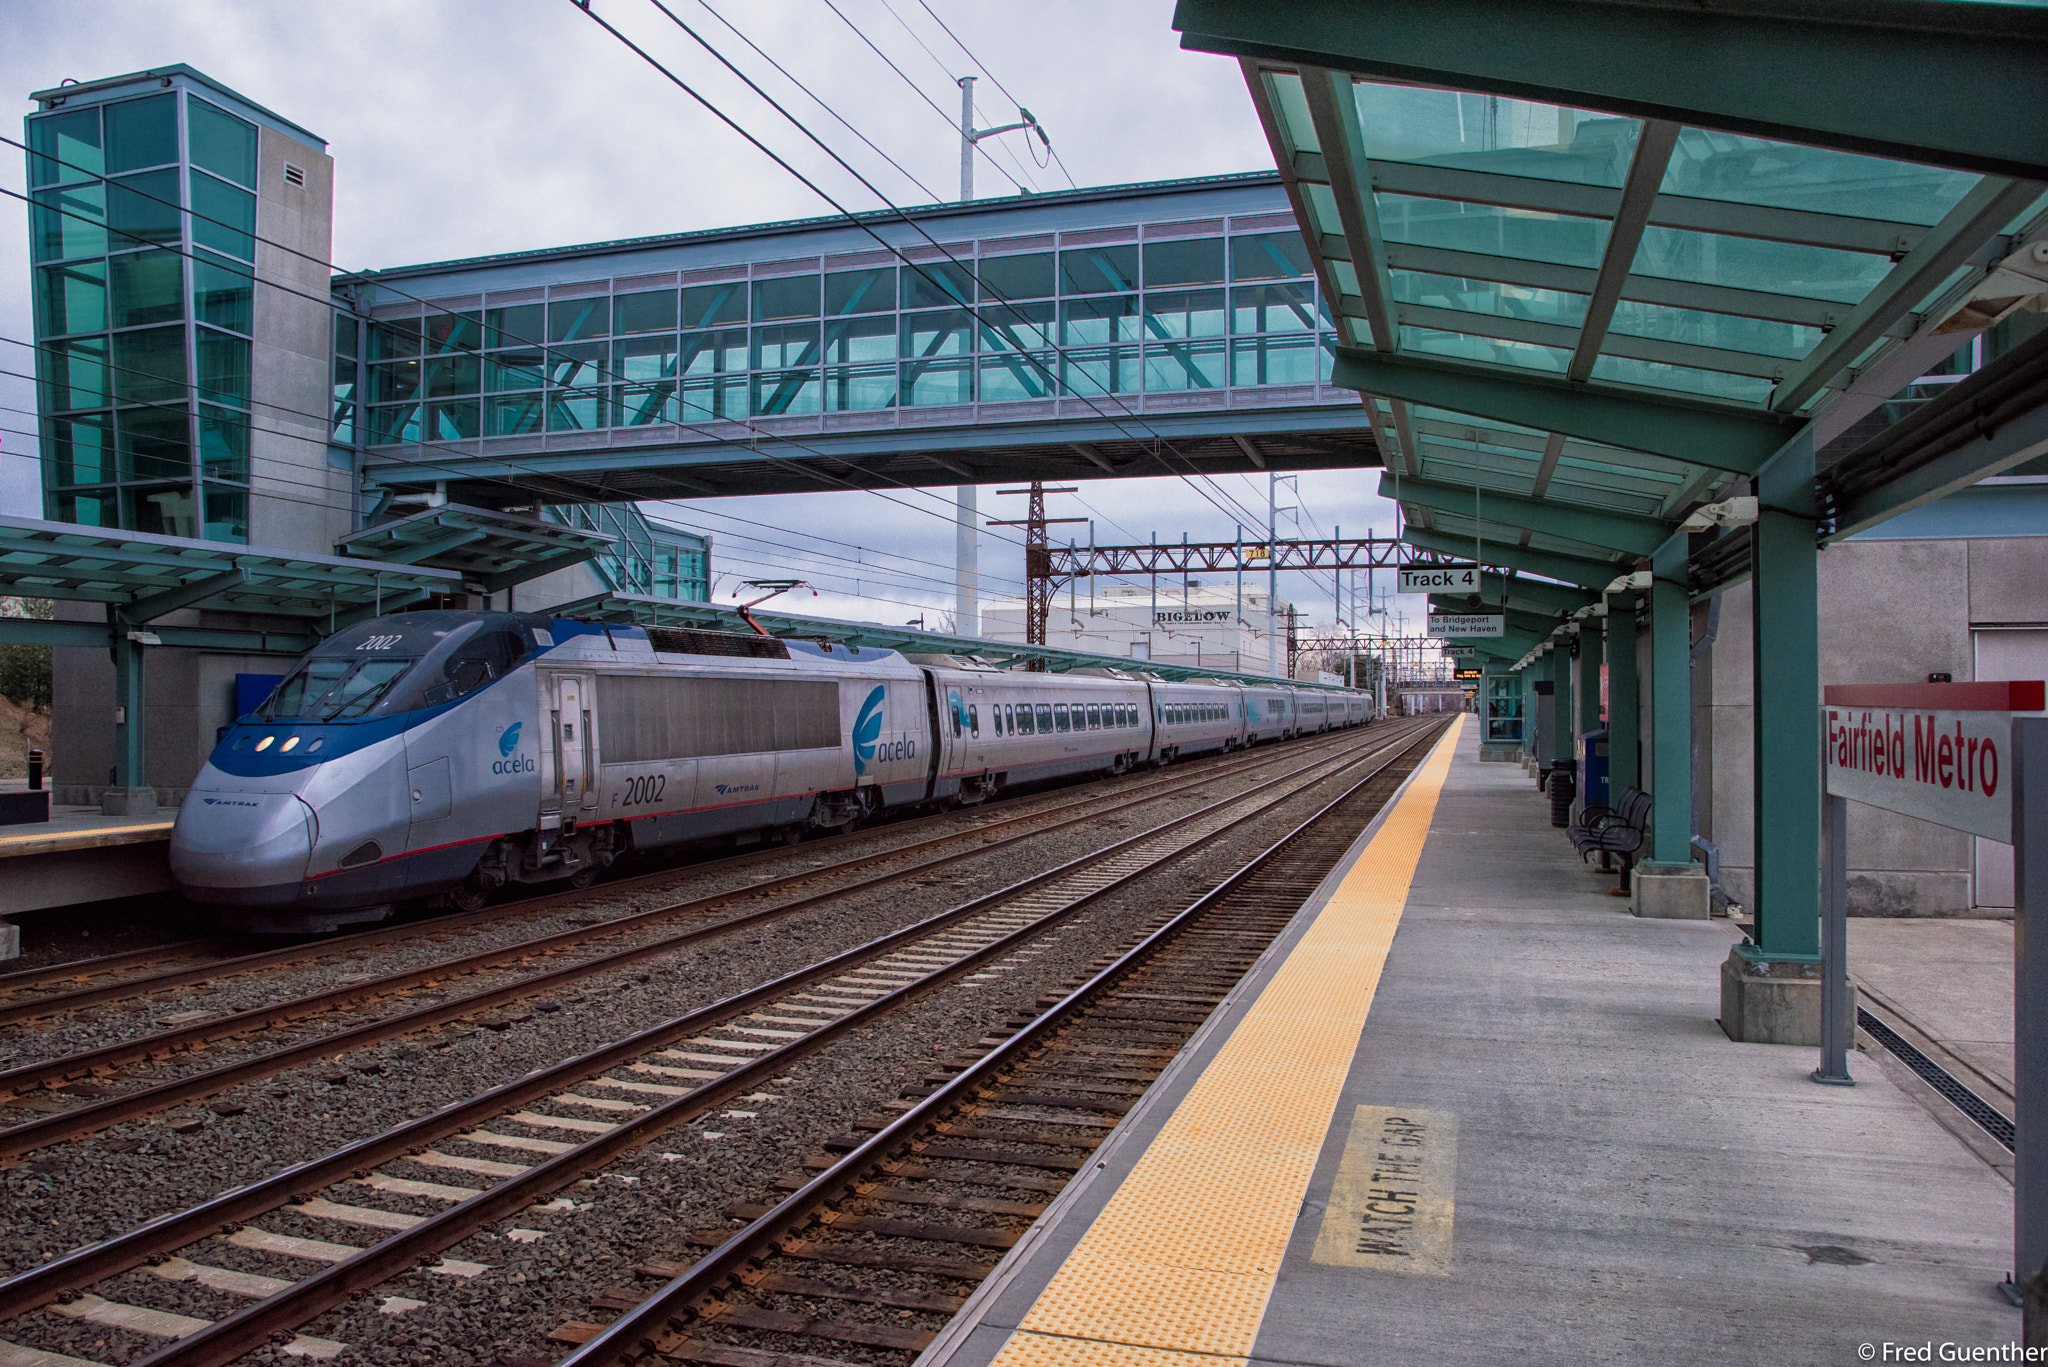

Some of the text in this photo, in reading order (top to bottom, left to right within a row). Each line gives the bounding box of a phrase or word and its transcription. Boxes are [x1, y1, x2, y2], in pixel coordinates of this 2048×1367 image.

[1249, 549, 1266, 558] 718
[1401, 570, 1474, 586] Track 4
[1156, 611, 1231, 622] BIGELOW
[1429, 616, 1489, 625] To Bridgeport
[1429, 625, 1497, 633] and New Haven
[355, 634, 403, 650] 2002
[1443, 648, 1465, 656] Track
[878, 731, 915, 763] acela
[1828, 710, 1998, 798] Fairfield Metro
[492, 753, 535, 775] acela
[611, 774, 666, 808] F 2002
[726, 784, 760, 794] AMTRAK
[215, 800, 260, 808] AMTRAK
[1356, 1117, 1428, 1257] WATCH THE GAP
